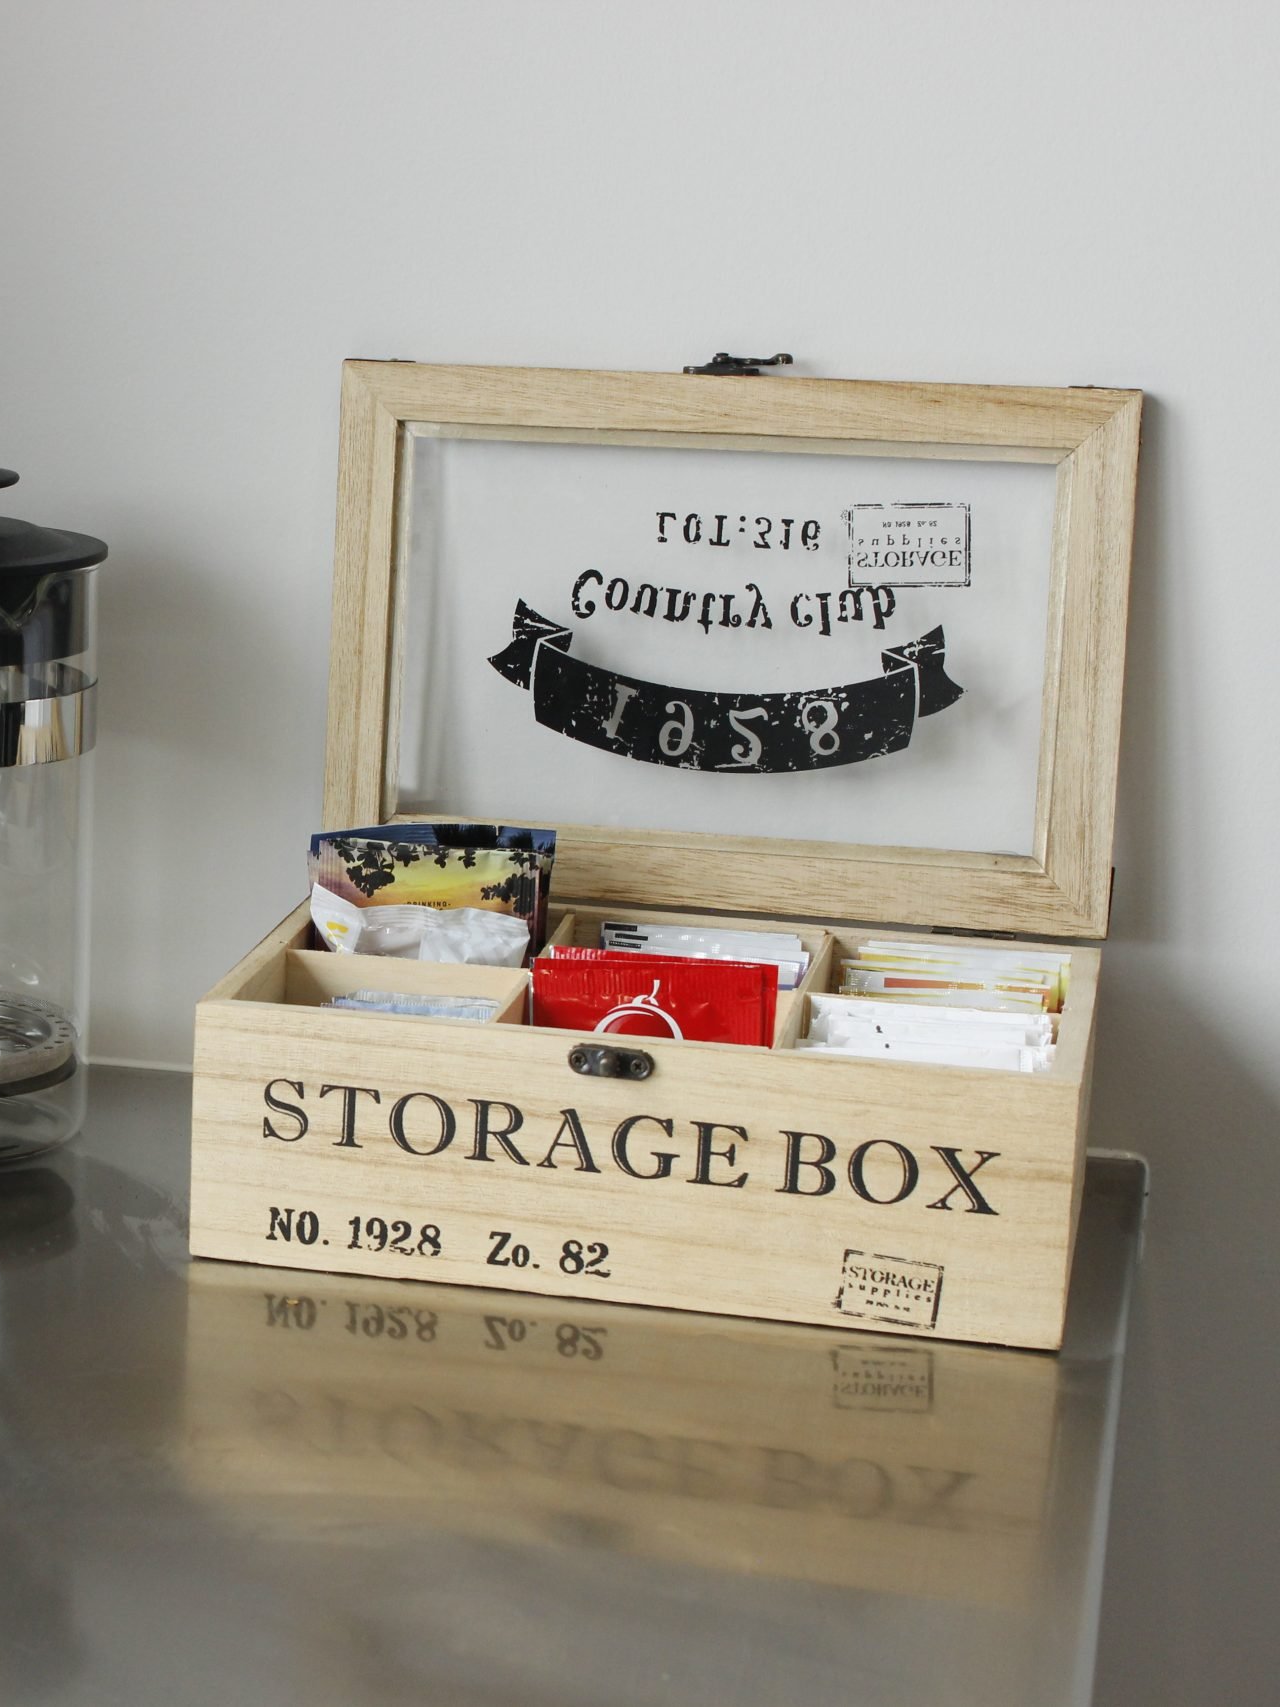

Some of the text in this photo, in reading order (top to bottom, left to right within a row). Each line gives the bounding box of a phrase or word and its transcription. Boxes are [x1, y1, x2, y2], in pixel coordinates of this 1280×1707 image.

[263, 1078, 1001, 1216] STORAGE BOX
[347, 1216, 442, 1257] 1928
[559, 1239, 611, 1279] 82
[849, 1266, 935, 1293] STORAGE
